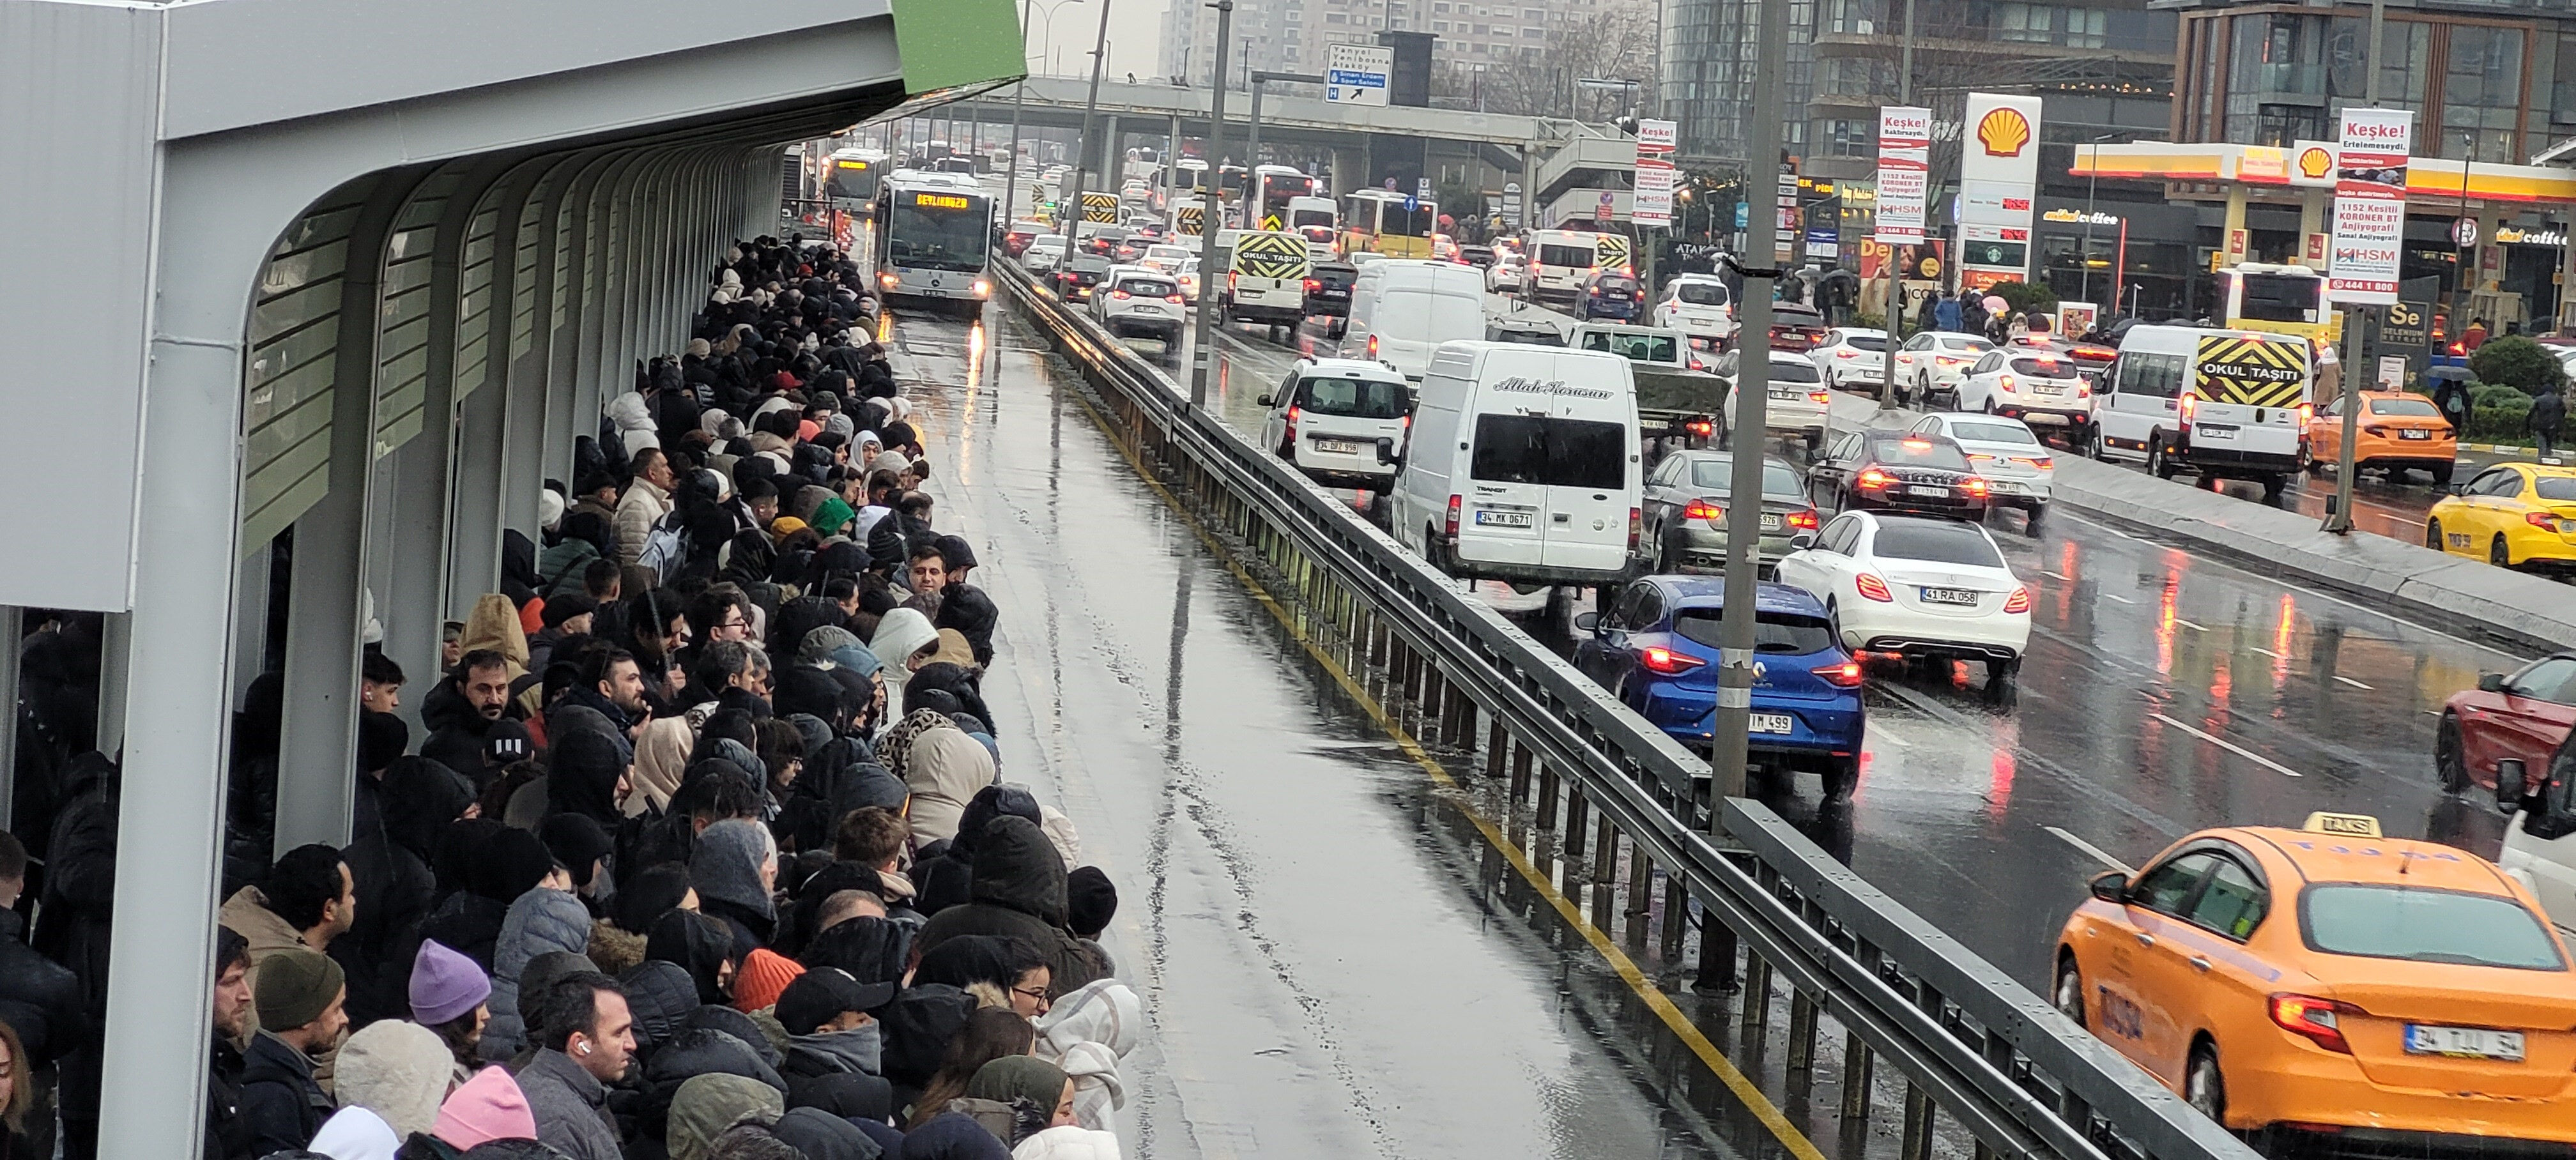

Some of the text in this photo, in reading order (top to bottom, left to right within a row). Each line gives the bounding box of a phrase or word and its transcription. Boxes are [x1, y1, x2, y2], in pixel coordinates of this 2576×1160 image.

[1334, 46, 1370, 56] Yanyol
[1333, 54, 1389, 65] Yenibosna
[1332, 61, 1369, 72] Ataköy
[1330, 88, 1337, 98] H
[1885, 116, 1926, 130] Keşke!
[1642, 127, 1673, 137] Keşke!
[2347, 122, 2405, 141] Keşke!
[2343, 141, 2405, 151] Ertelemeseydi.
[1894, 205, 1922, 214] HSM
[2368, 204, 2398, 213] Kesitli
[2340, 213, 2382, 222] KORONER
[2342, 222, 2394, 232] Anjiyografi
[1675, 243, 1706, 254] ATAK
[1243, 252, 1269, 261] OKUL
[2356, 248, 2395, 261] HSM
[2375, 283, 2393, 291] 800
[2389, 303, 2420, 326] Se
[2204, 363, 2298, 381] OKUL TAŞITI
[1482, 514, 1529, 524] 34 MK 0671
[1926, 590, 1975, 602] 41 RA 058
[1752, 715, 1788, 729] IM 499
